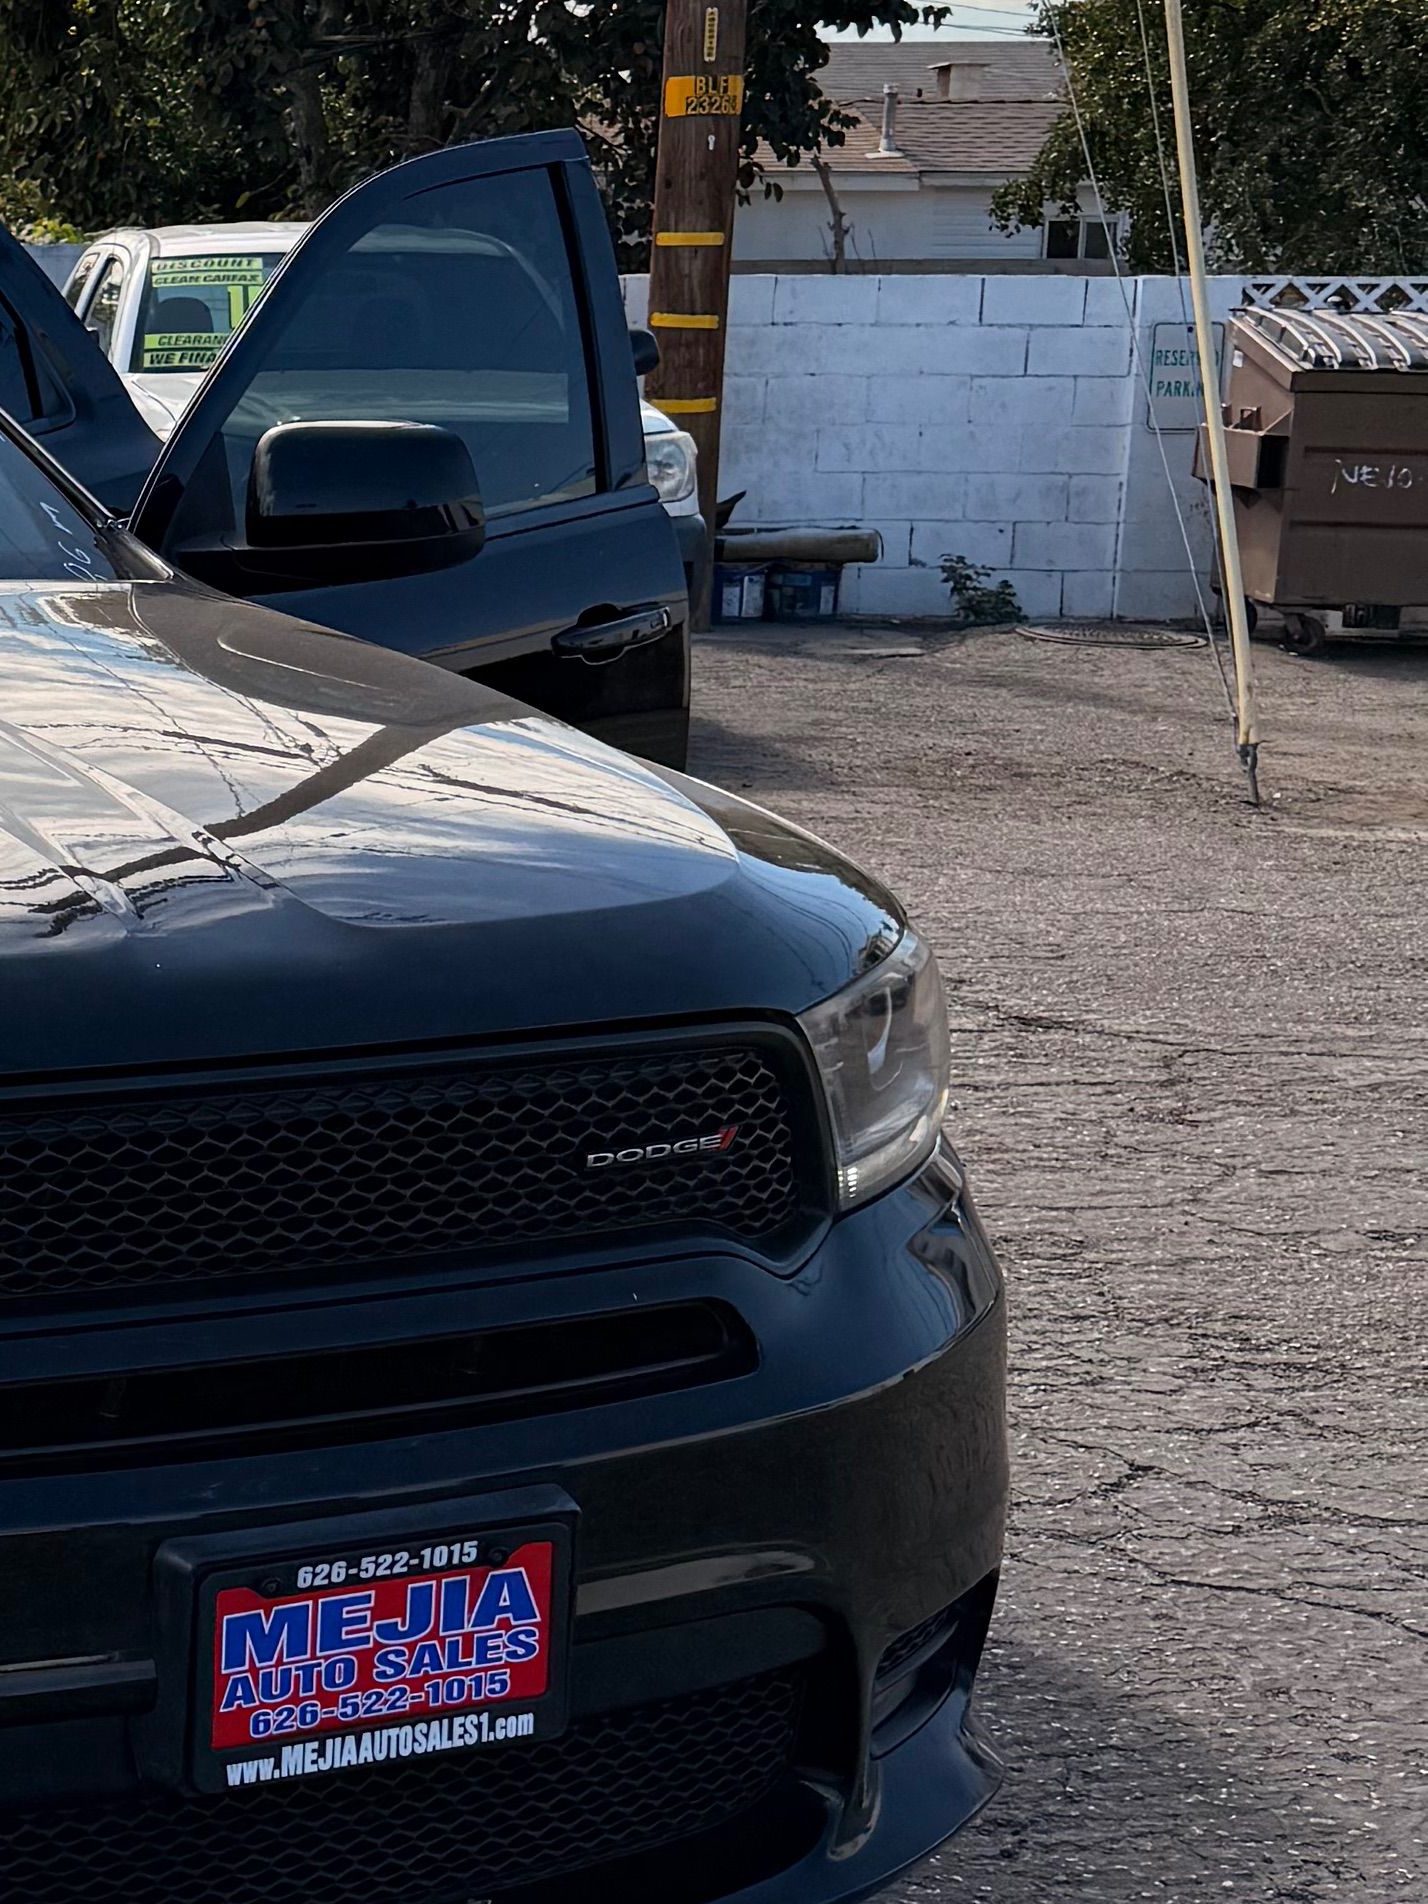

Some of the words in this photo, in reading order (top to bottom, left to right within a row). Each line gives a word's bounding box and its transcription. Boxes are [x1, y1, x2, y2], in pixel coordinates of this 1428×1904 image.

[154, 275, 202, 286] CLEAN
[203, 273, 260, 285] CARFAX
[150, 353, 176, 365] WE
[178, 351, 218, 364] FINA
[586, 1134, 724, 1168] DODGE
[296, 1540, 479, 1589] 626-522-1015
[221, 1566, 542, 1675] MEJIA
[219, 1654, 358, 1713] AUTO
[372, 1626, 540, 1683] SALES
[249, 1668, 511, 1739] 626-522-1015
